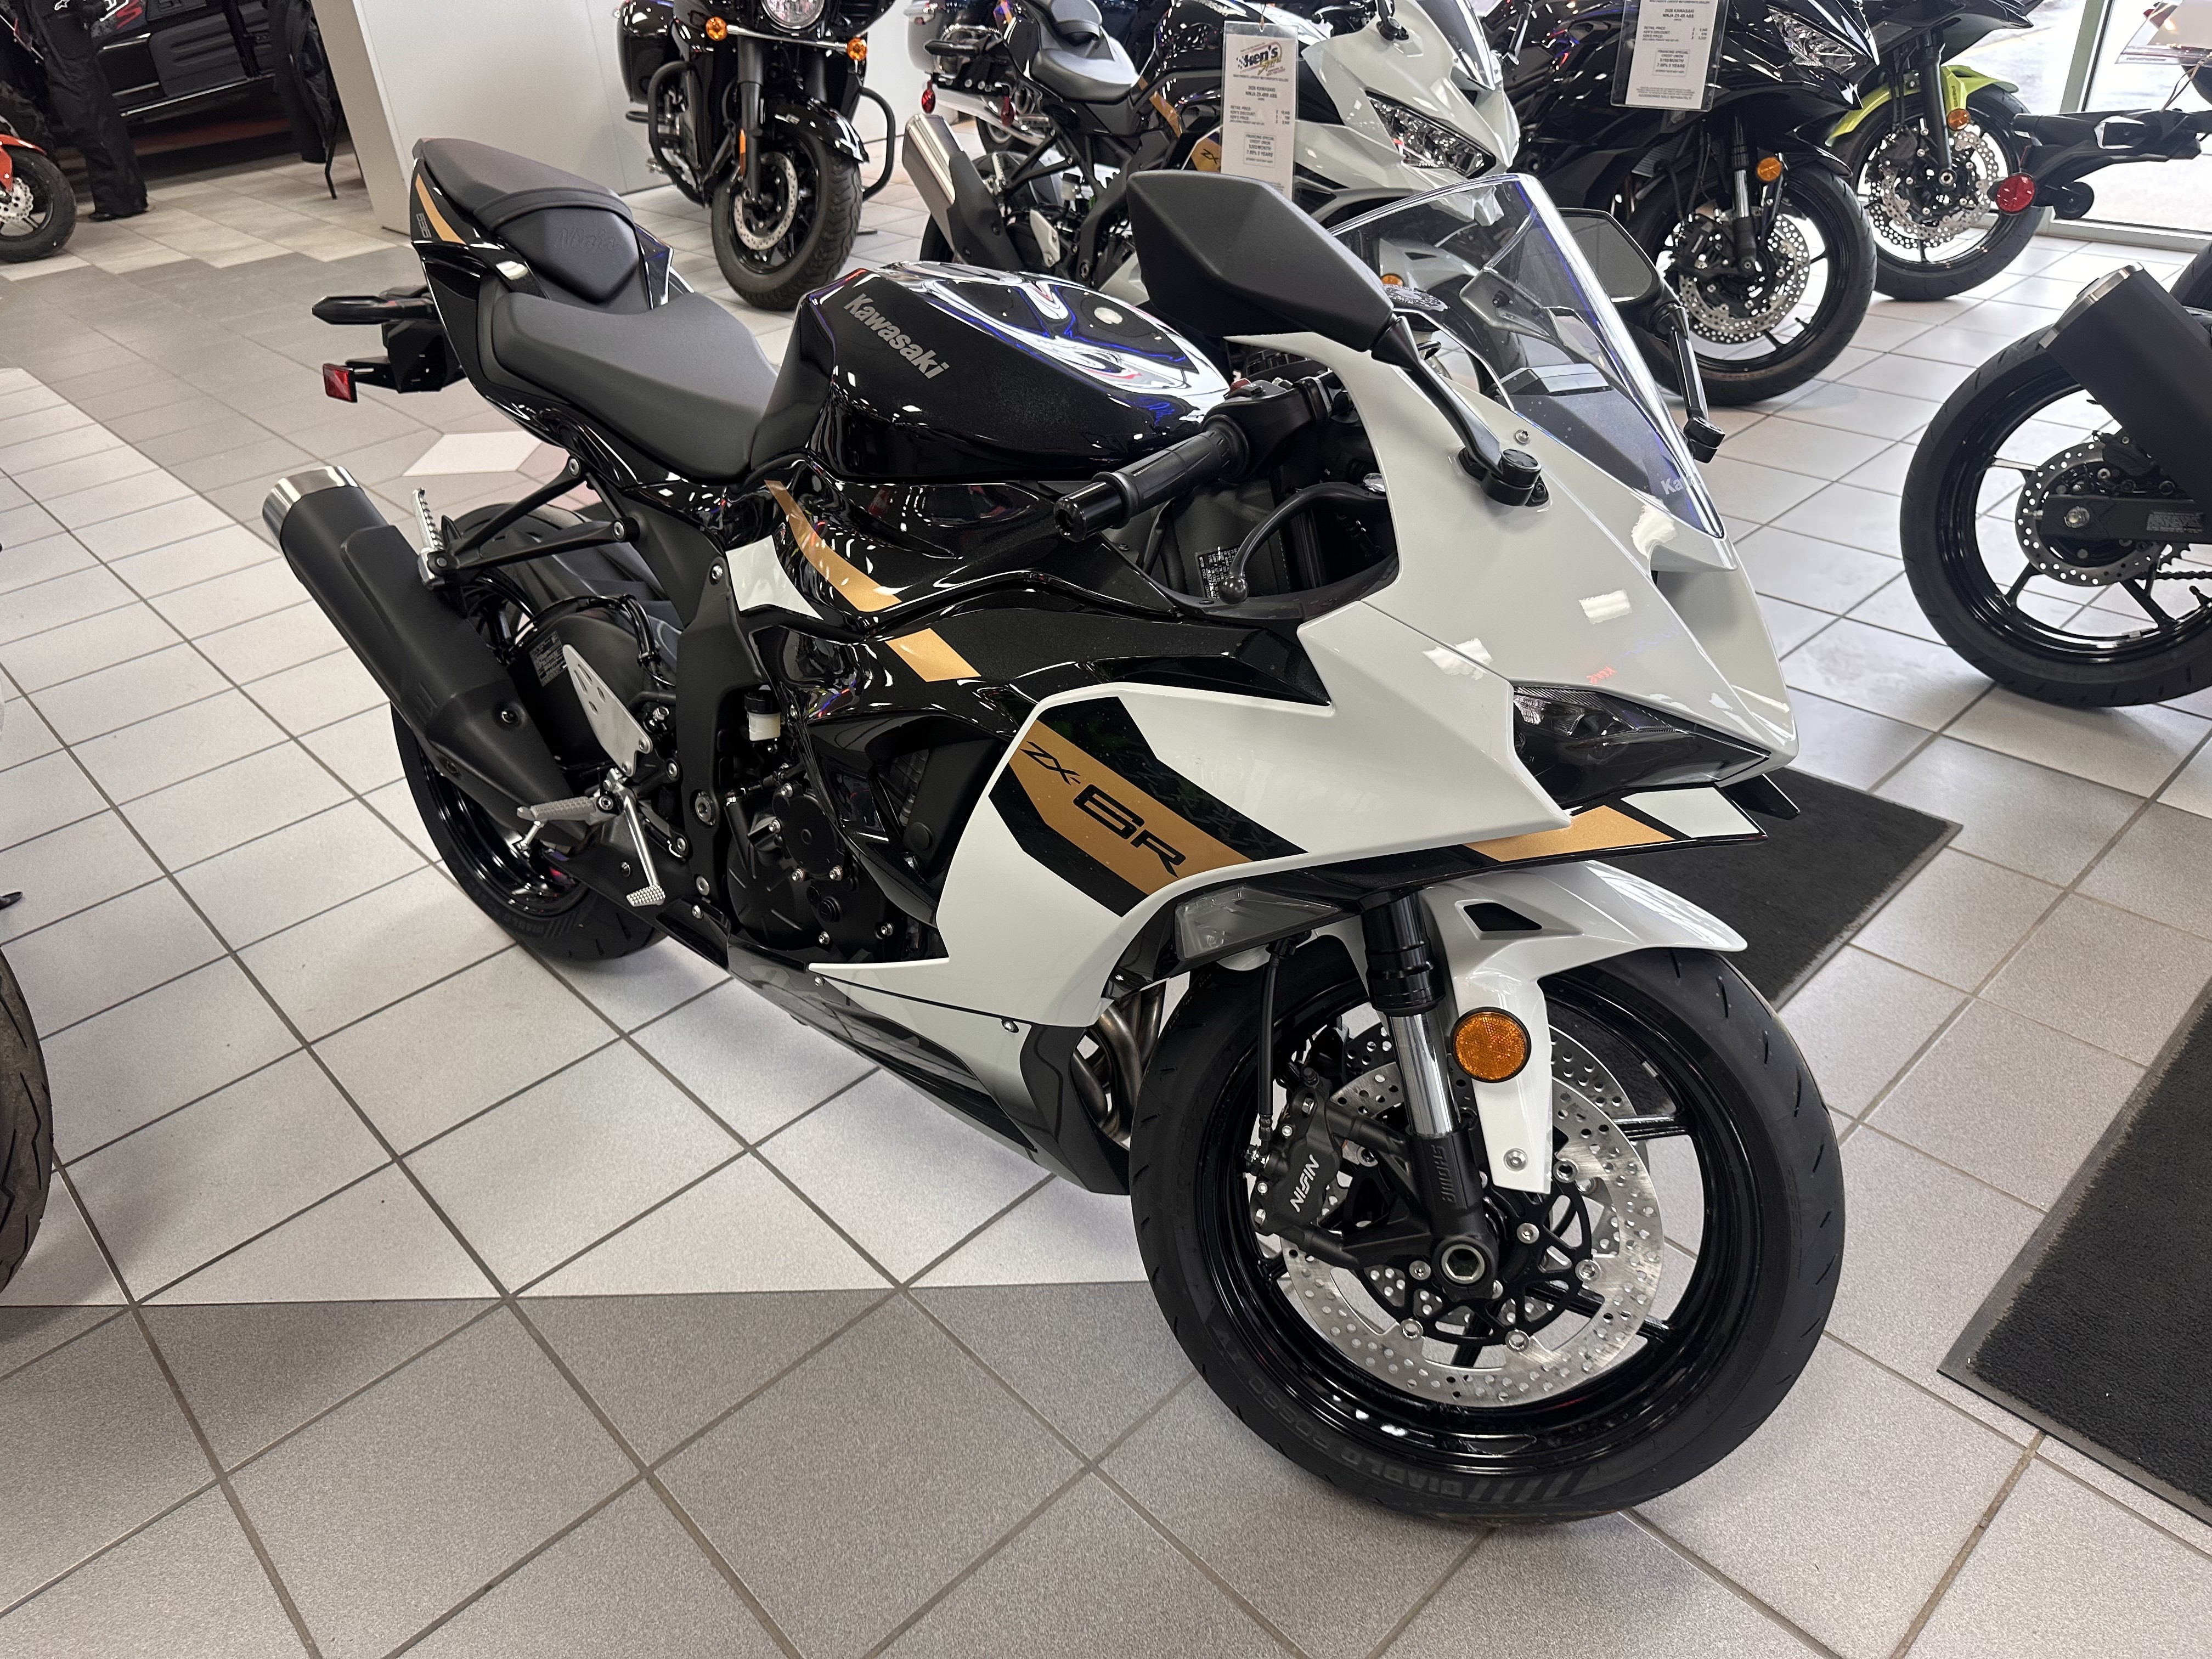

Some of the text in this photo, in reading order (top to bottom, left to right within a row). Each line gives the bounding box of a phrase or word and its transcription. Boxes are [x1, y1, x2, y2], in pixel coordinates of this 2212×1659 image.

[416, 212, 432, 238] 636
[843, 293, 950, 379] Kawasaki
[1290, 1154, 1319, 1212] NISSIN
[1430, 1144, 1457, 1204] SHOWA
[1341, 1446, 1464, 1498] DIABLO
